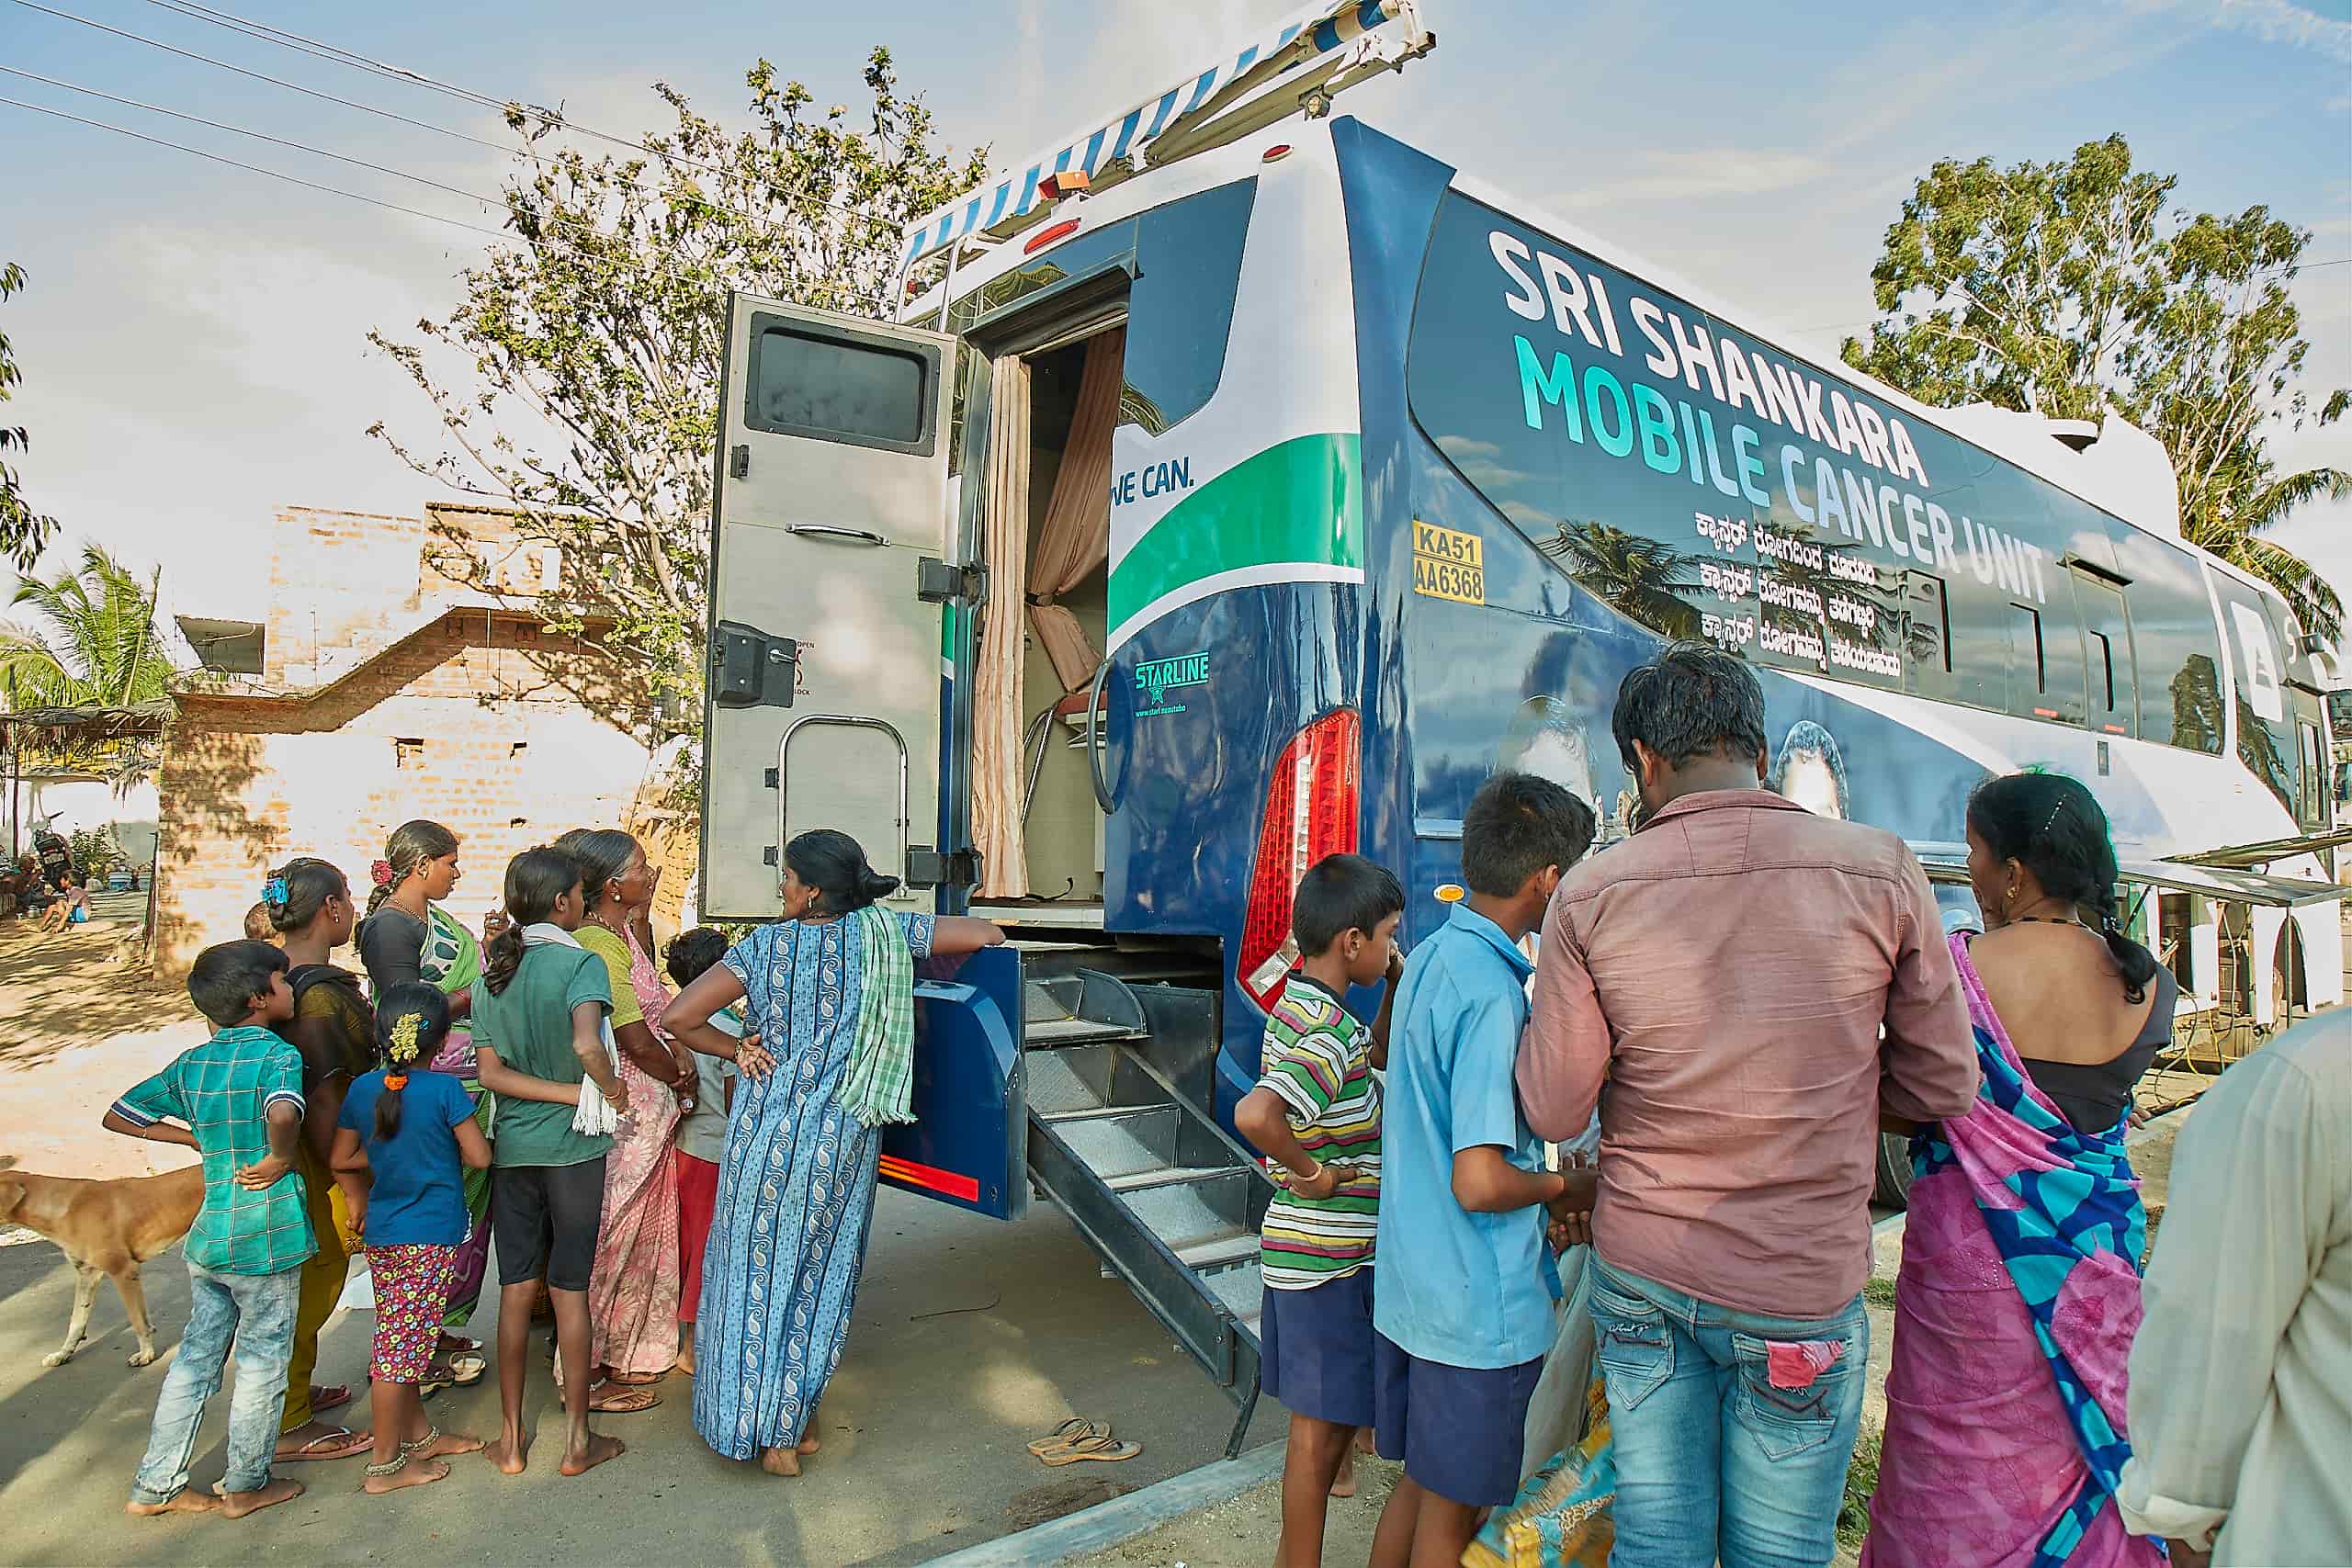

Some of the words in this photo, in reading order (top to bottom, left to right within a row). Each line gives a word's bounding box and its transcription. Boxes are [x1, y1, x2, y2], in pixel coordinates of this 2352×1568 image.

[1488, 230, 1624, 356] SRI
[1630, 296, 1928, 488] SHANKARA
[1142, 456, 1194, 498] CAN.
[1513, 334, 1771, 509] MOBILE
[1780, 444, 1960, 574] CANCER
[1962, 516, 2048, 604] UNIT
[1419, 526, 1475, 562] KA51
[1416, 559, 1483, 600] AA6368
[1136, 657, 1209, 689] STARLINE
